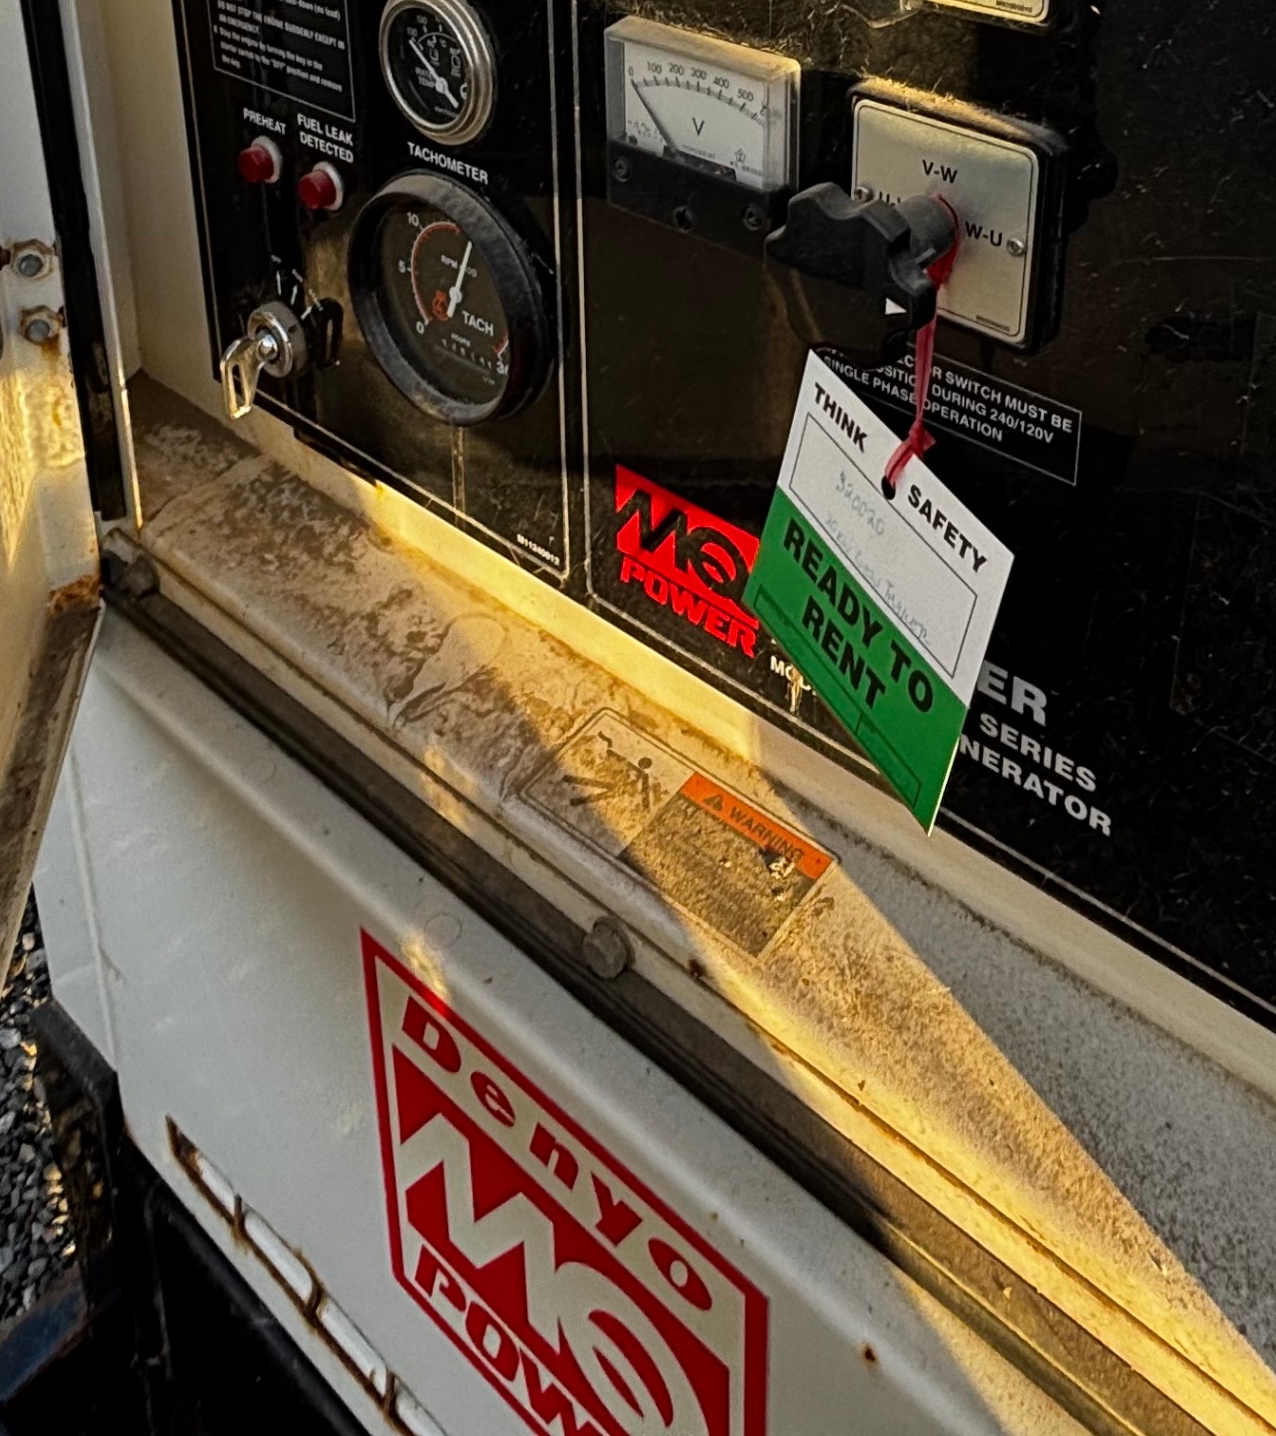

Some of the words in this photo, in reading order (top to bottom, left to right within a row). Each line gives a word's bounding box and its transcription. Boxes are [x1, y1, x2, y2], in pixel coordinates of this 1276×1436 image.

[628, 66, 634, 77] 0
[647, 62, 662, 75] 100
[668, 62, 684, 75] 200
[690, 67, 707, 80] 300
[713, 76, 730, 89] 400
[737, 88, 754, 102] 500
[243, 107, 286, 135] PREHEAT
[297, 114, 323, 134] FUEL
[325, 124, 354, 146] LEAK
[300, 131, 354, 163] DETECTED
[692, 117, 705, 136] V
[407, 142, 489, 185] TACHOMETER
[922, 159, 958, 183] V-W
[407, 212, 419, 226] 10
[965, 221, 1003, 247] W-U
[416, 322, 424, 334] 0
[461, 310, 494, 337] TACH
[824, 356, 869, 385] SINGLE
[873, 377, 918, 405] PHASE
[923, 398, 1003, 442] OPERATION
[932, 384, 987, 416] DURING
[990, 409, 1054, 444] 240/120V
[945, 371, 1001, 404] SWITCH
[1005, 395, 1048, 422] MUST
[1051, 413, 1073, 433] BE
[815, 383, 868, 454] THINK
[908, 484, 987, 573] SAFETY
[621, 556, 757, 658] POWER
[784, 517, 883, 648] READY
[890, 639, 934, 713] TO
[802, 594, 887, 709] RENT
[980, 713, 1096, 792] SERIES
[959, 734, 1112, 836] NERATOR
[729, 806, 805, 862] WARNING
[402, 995, 712, 1311] Denyo
[414, 1243, 609, 1436] POW
